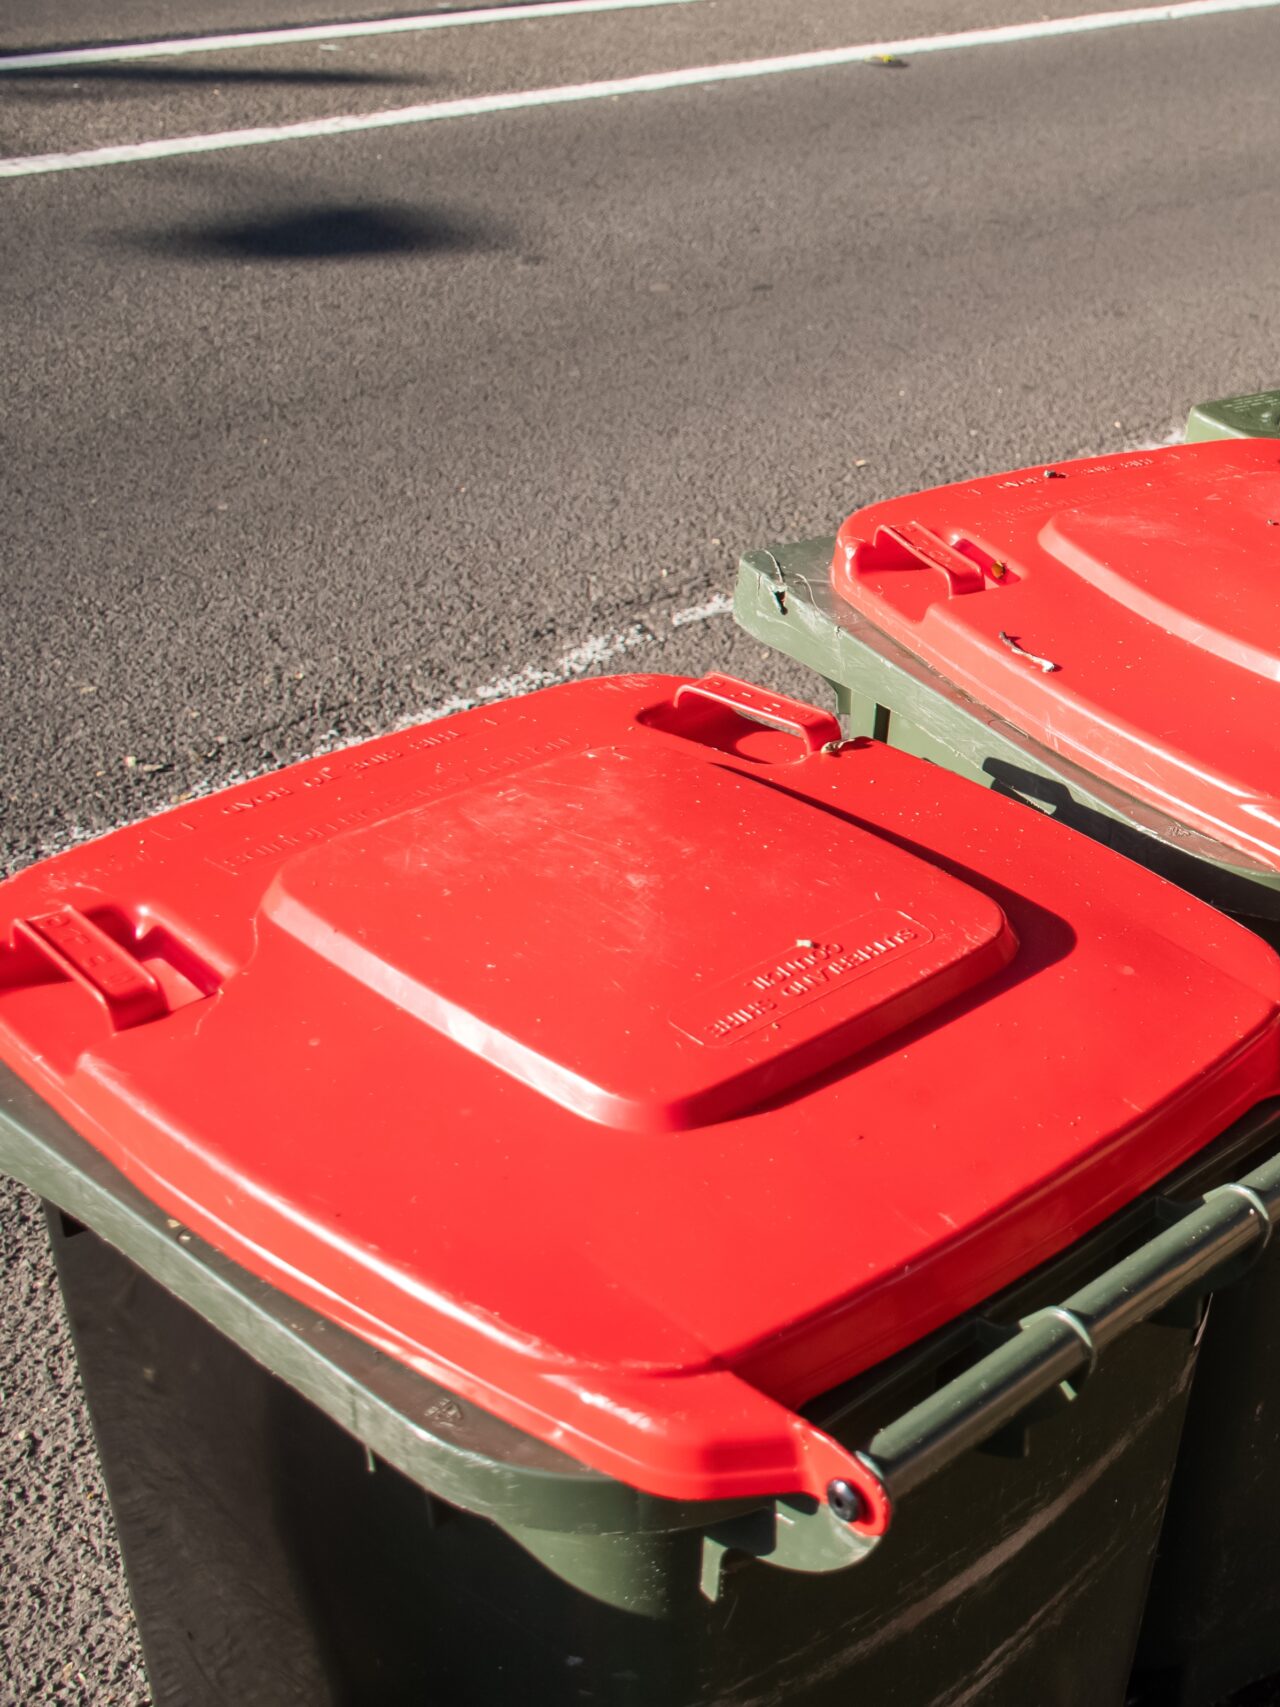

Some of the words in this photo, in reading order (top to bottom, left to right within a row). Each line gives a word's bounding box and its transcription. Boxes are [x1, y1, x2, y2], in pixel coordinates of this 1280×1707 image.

[303, 767, 341, 788] TO
[222, 787, 294, 814] ROAD
[746, 942, 844, 990] COUNCIL
[780, 928, 918, 999] SUTHERLAND
[704, 998, 778, 1038] SHIRE
